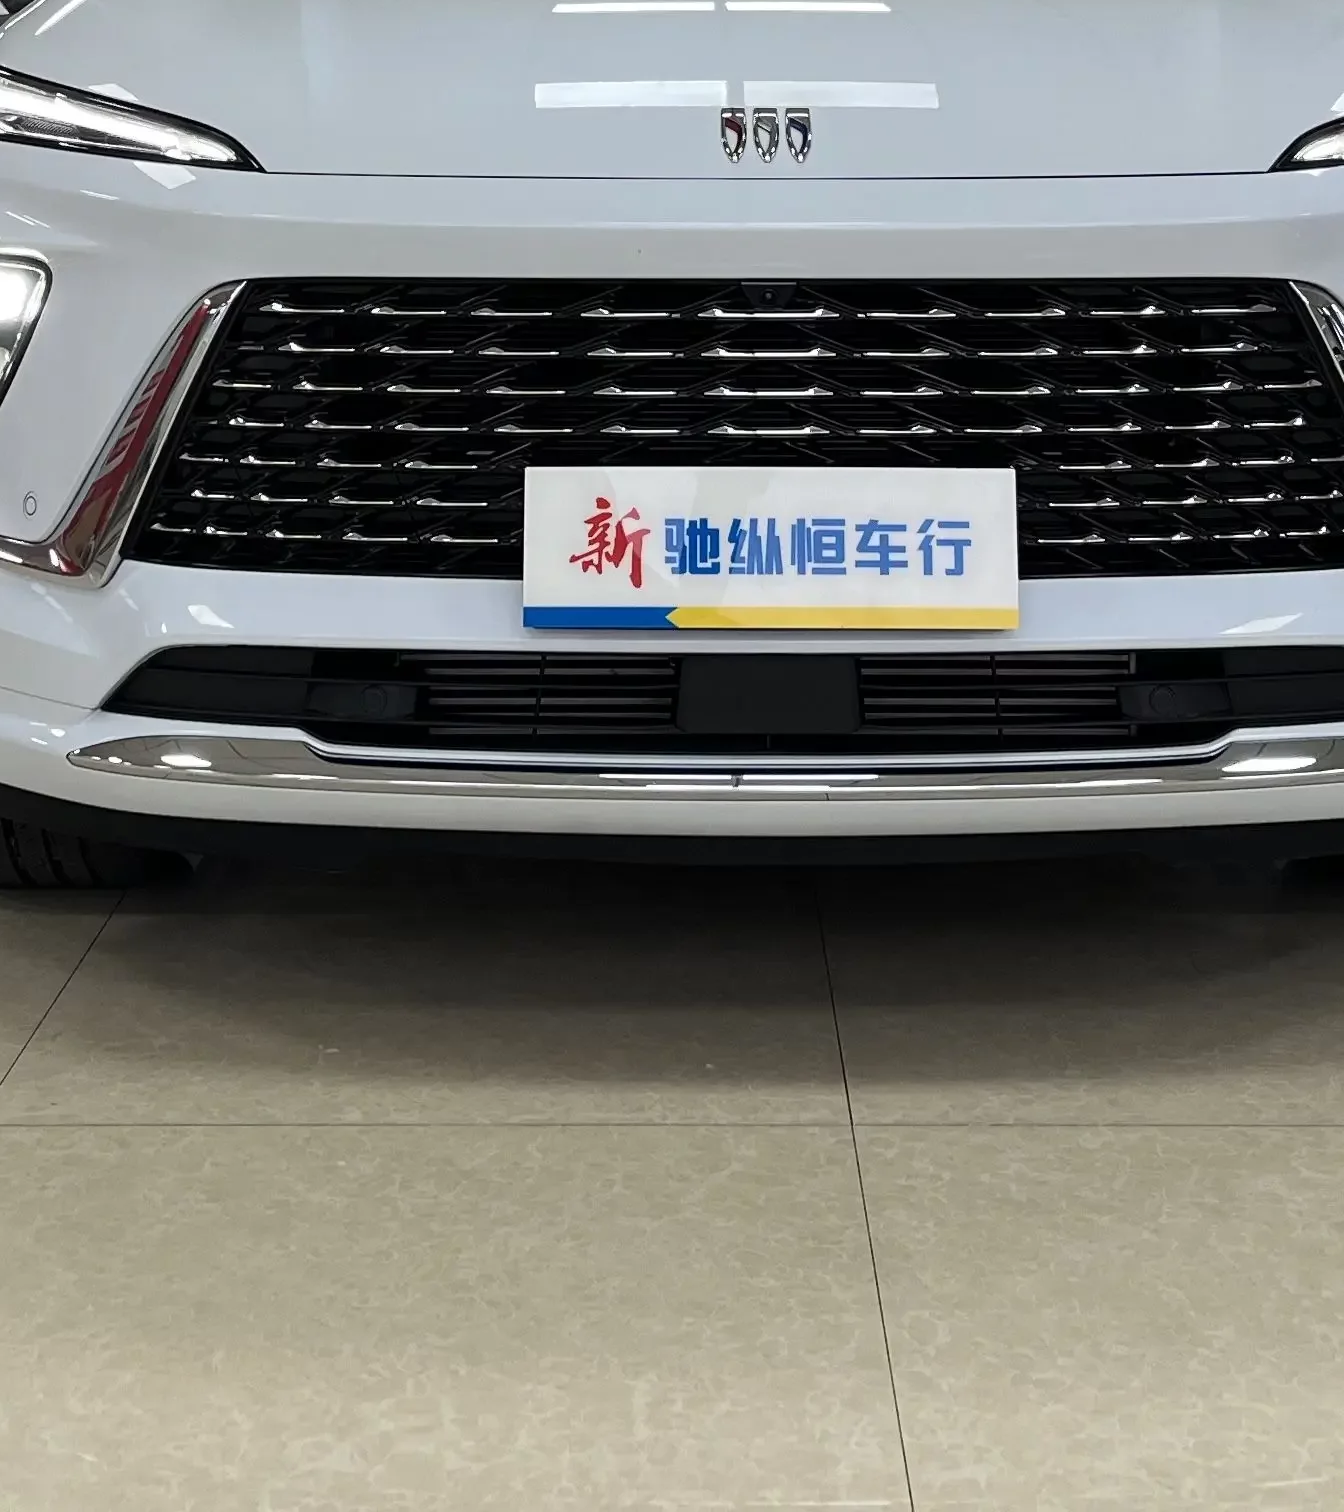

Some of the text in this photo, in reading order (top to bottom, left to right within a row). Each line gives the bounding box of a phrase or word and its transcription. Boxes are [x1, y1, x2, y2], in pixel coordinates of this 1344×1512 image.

[569, 497, 971, 589] 新驰纵恒车行
